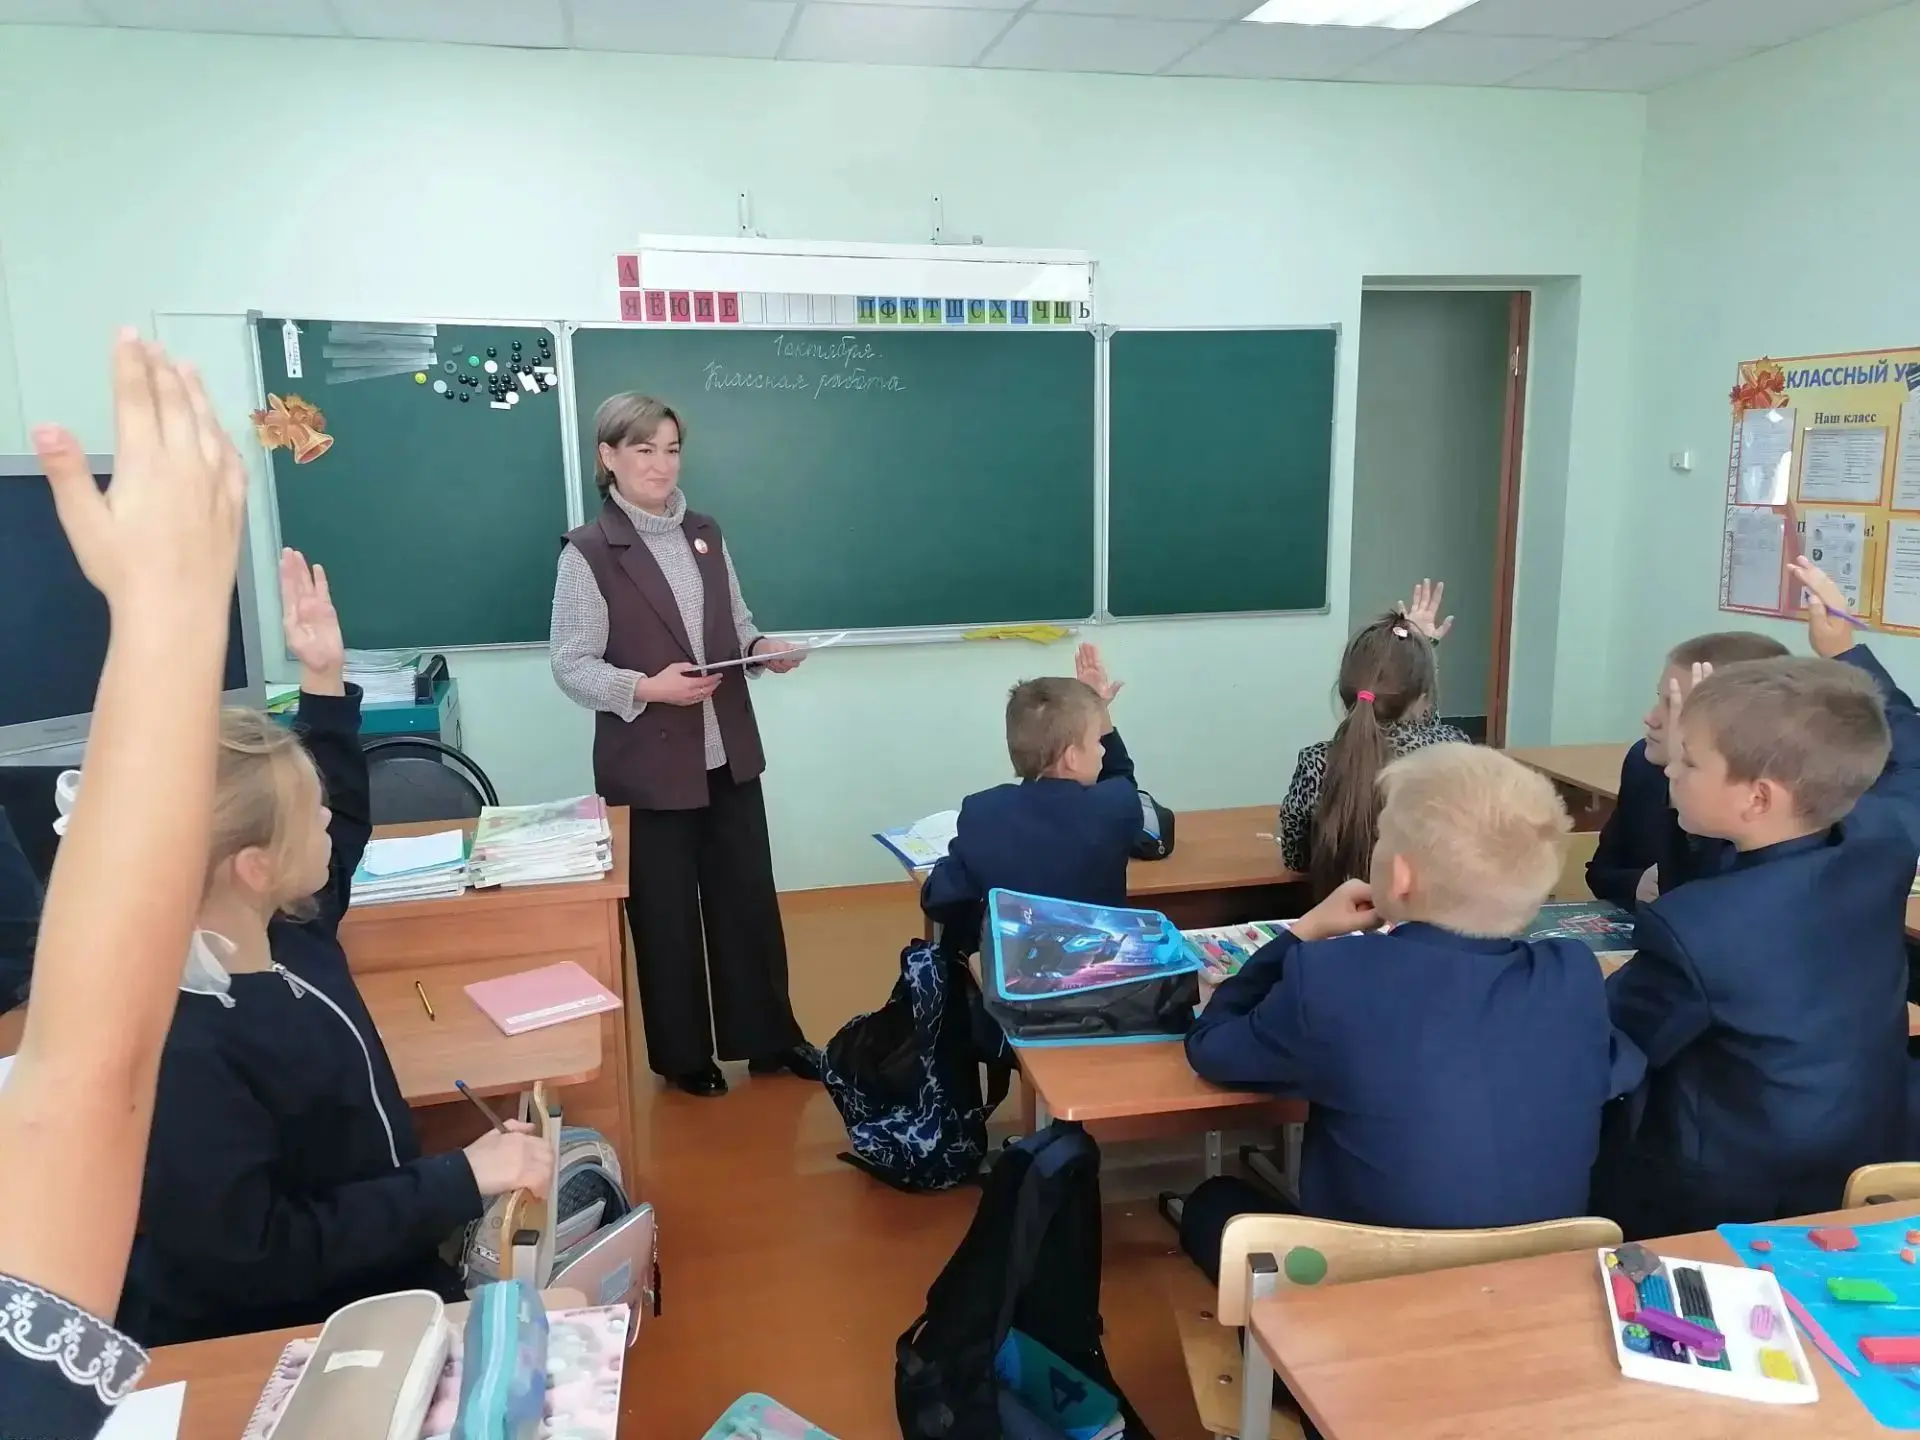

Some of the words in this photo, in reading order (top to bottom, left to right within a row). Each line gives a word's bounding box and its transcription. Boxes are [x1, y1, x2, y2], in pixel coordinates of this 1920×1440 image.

[670, 296, 690, 317] Ю
[859, 297, 876, 319] П
[879, 298, 897, 319] Ф
[903, 298, 918, 319] К
[925, 299, 940, 319] Т
[970, 299, 983, 320] С
[991, 299, 1007, 319] Х
[1013, 299, 1027, 322] Ц
[1035, 299, 1050, 320] Ч
[703, 360, 809, 393] Классная
[813, 367, 907, 400] работа
[1786, 358, 1889, 389] КЛАССНЫЙ
[1814, 412, 1840, 425] Наш
[1843, 412, 1878, 424] класс
